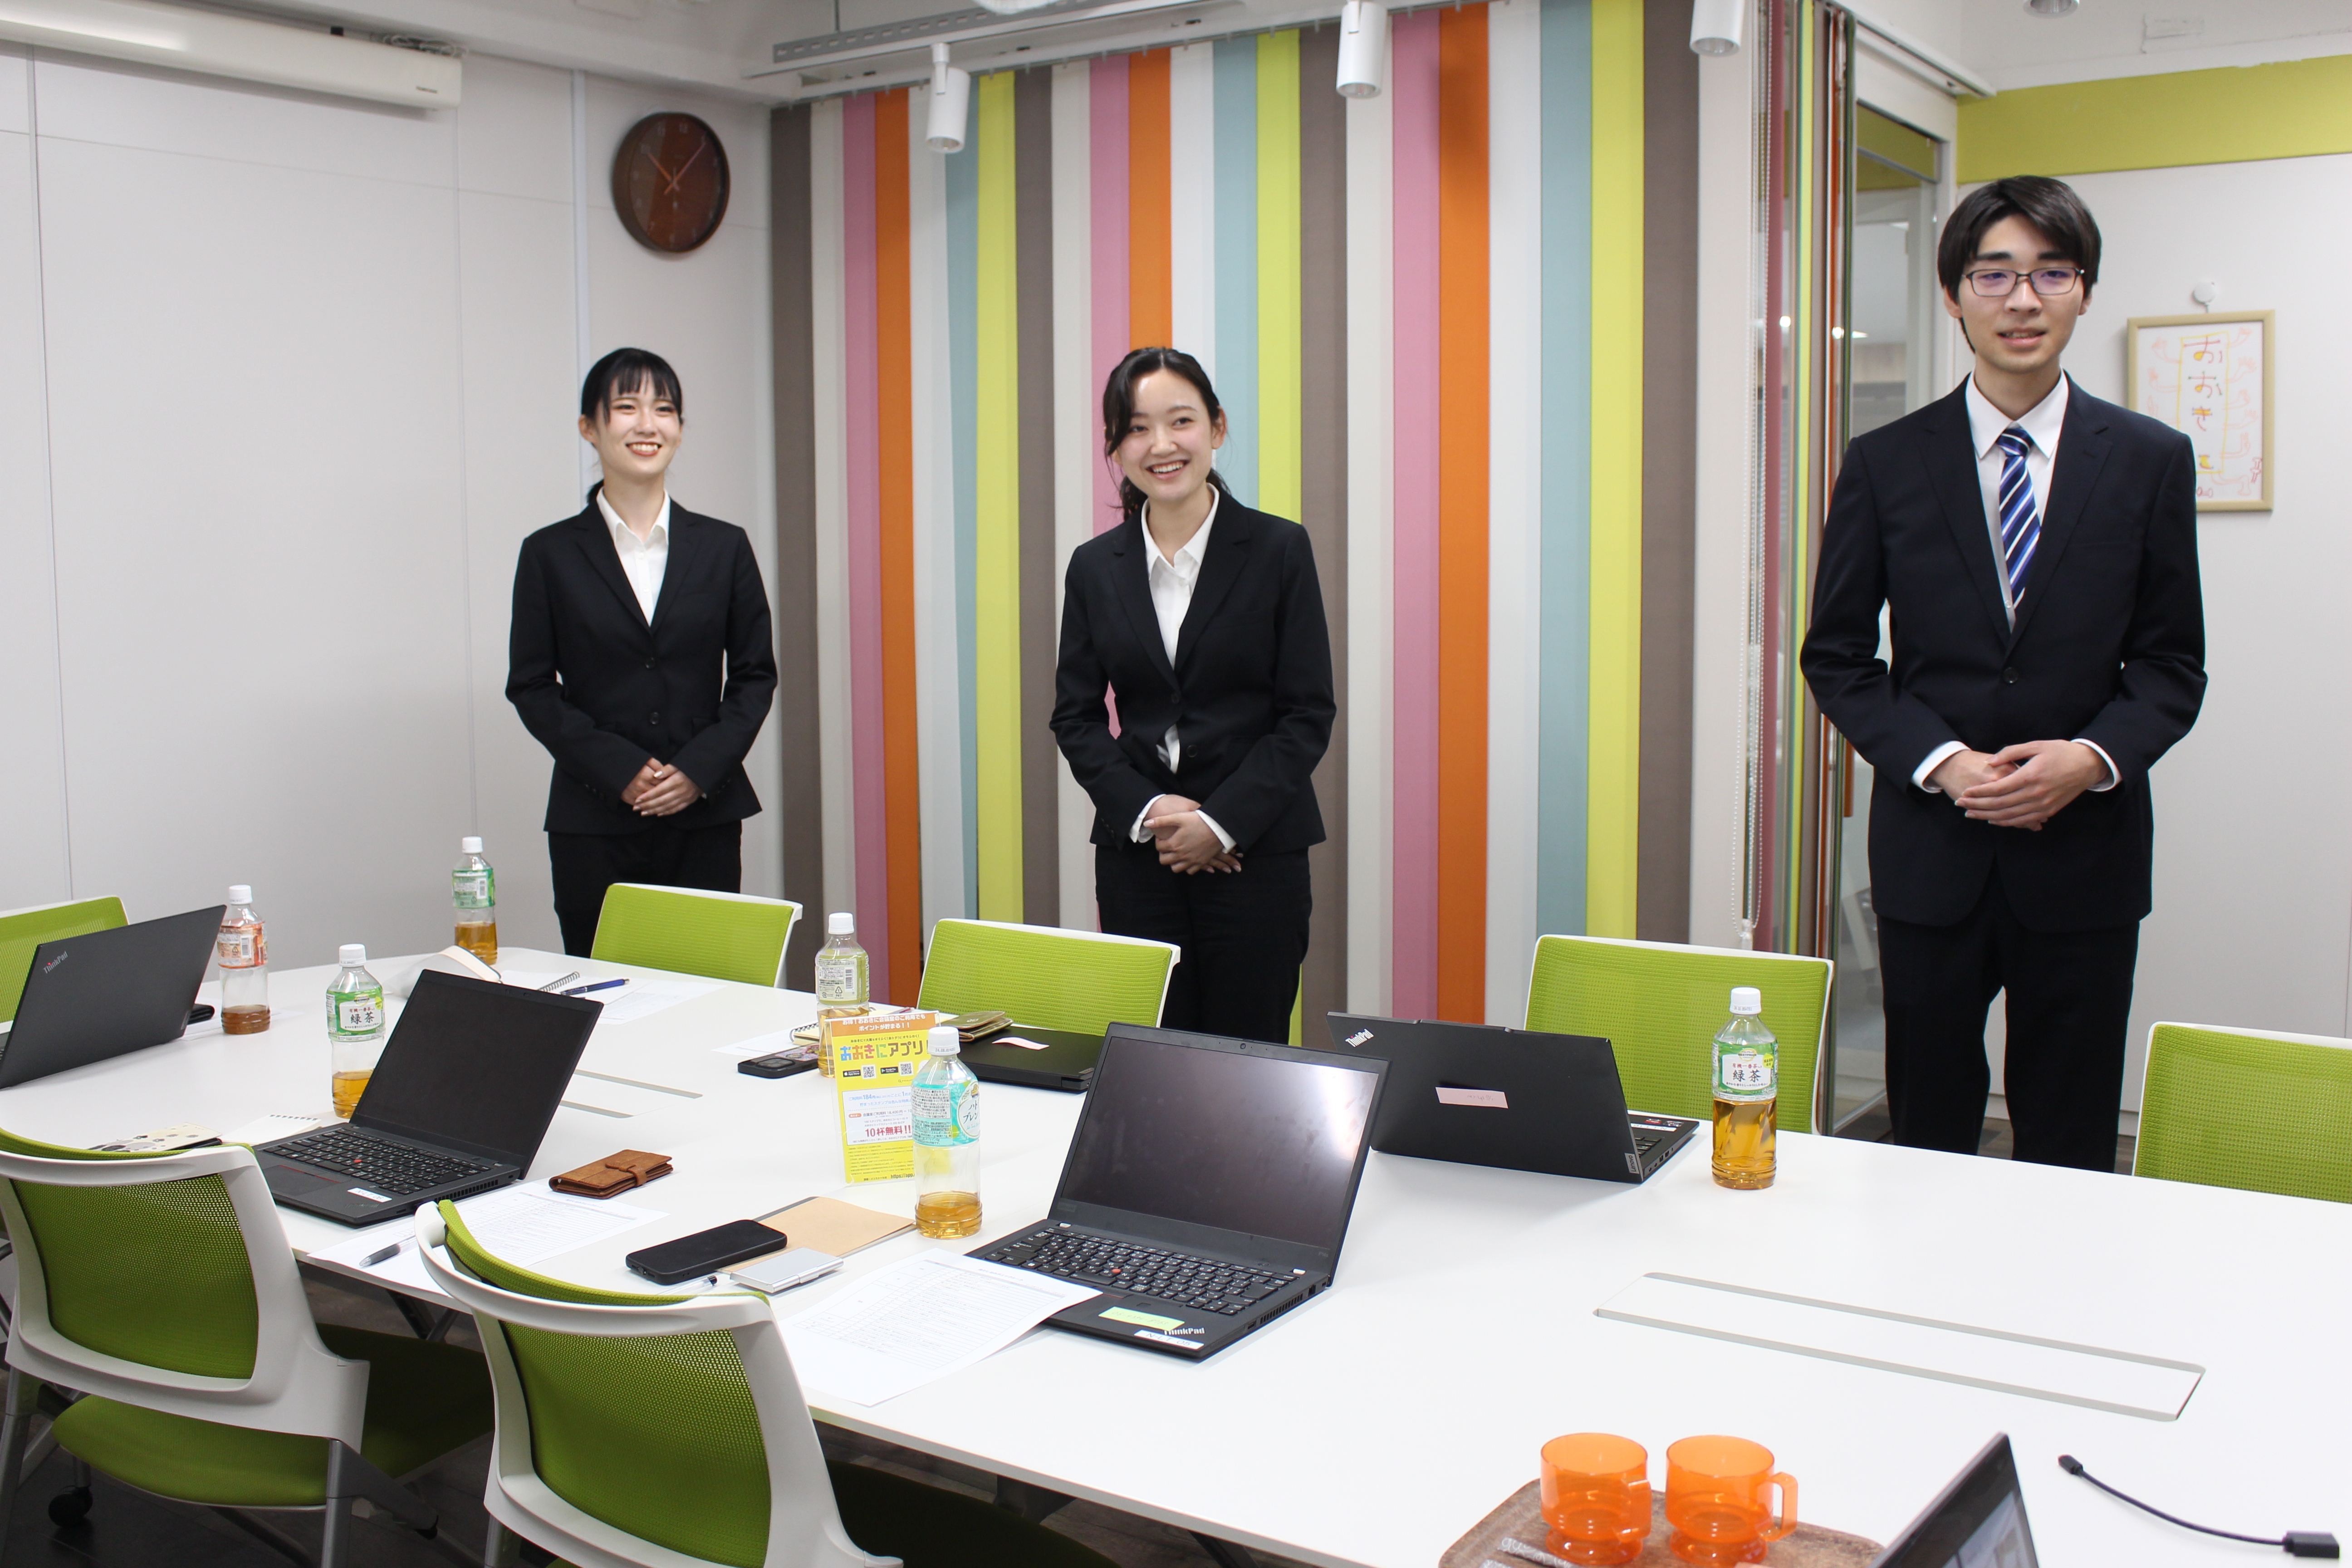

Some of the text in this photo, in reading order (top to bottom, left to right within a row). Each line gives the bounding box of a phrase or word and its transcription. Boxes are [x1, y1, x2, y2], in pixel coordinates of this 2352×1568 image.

[43, 950, 69, 974] ThinkPad
[858, 1022, 911, 1032] ポイントが貯まる！！
[1344, 1028, 1375, 1048] ThinkPad
[1732, 1069, 1762, 1083] 緑茶
[968, 1100, 979, 1111] ハト
